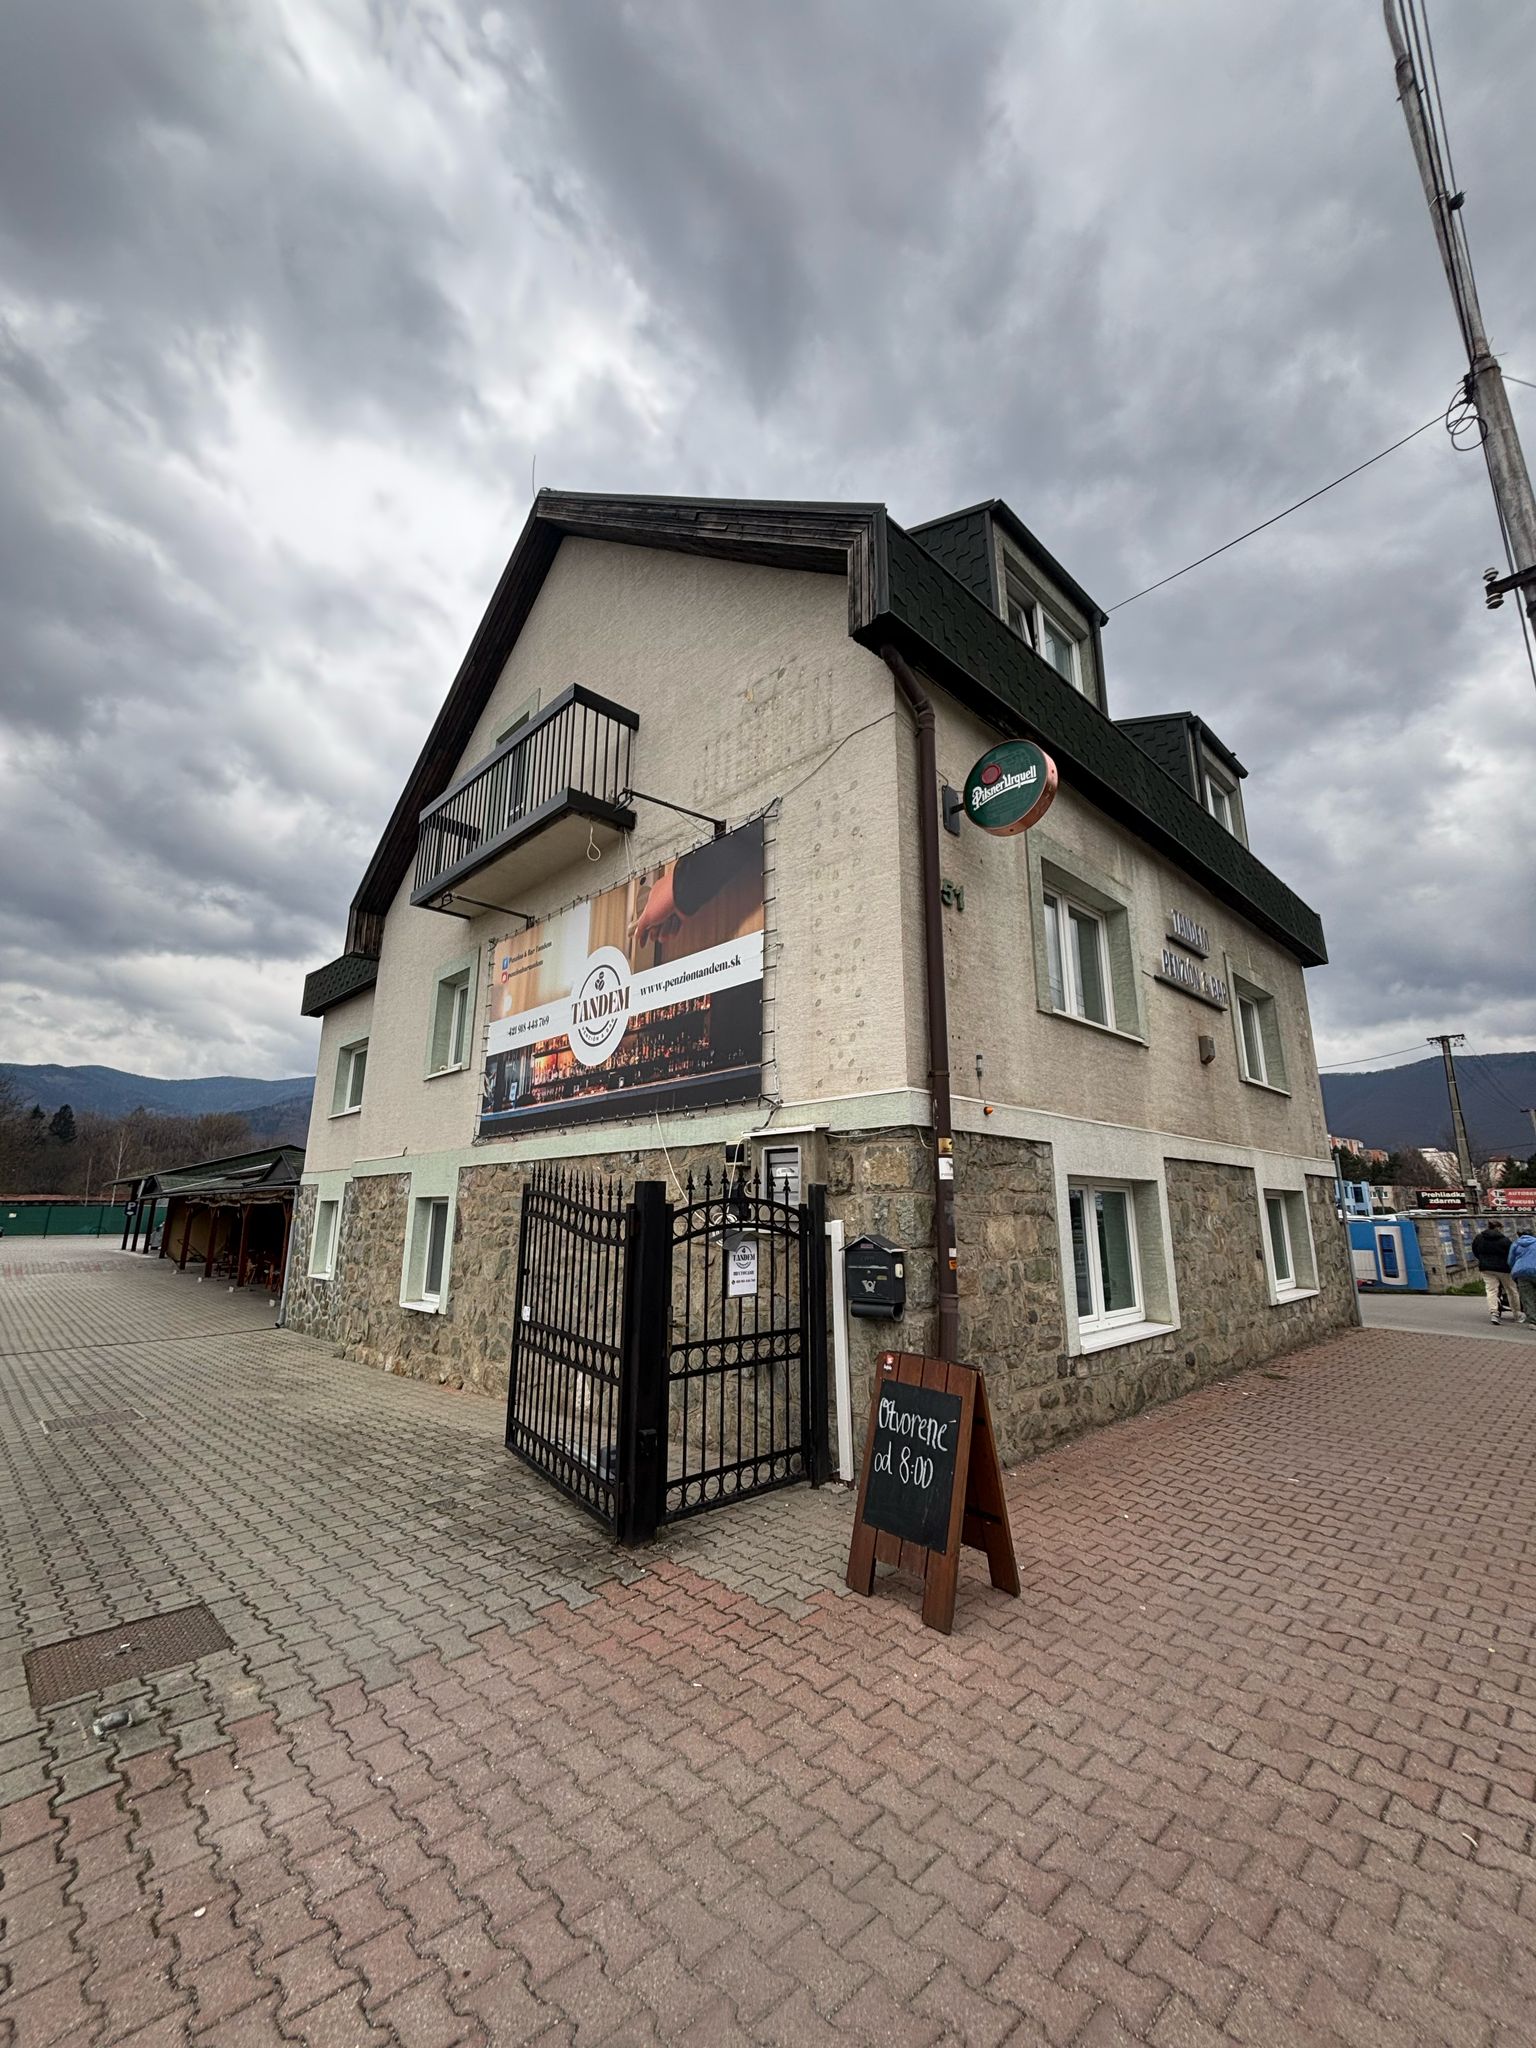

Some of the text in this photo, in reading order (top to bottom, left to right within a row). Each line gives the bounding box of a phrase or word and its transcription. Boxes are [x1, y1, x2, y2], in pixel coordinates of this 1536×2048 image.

[972, 765, 1037, 811] Pilsner Urquell
[640, 955, 742, 996] www.penziontandem.sk
[571, 986, 630, 1025] TANDEM
[878, 1397, 957, 1451] Otvorené
[874, 1441, 934, 1489] od 8:00
